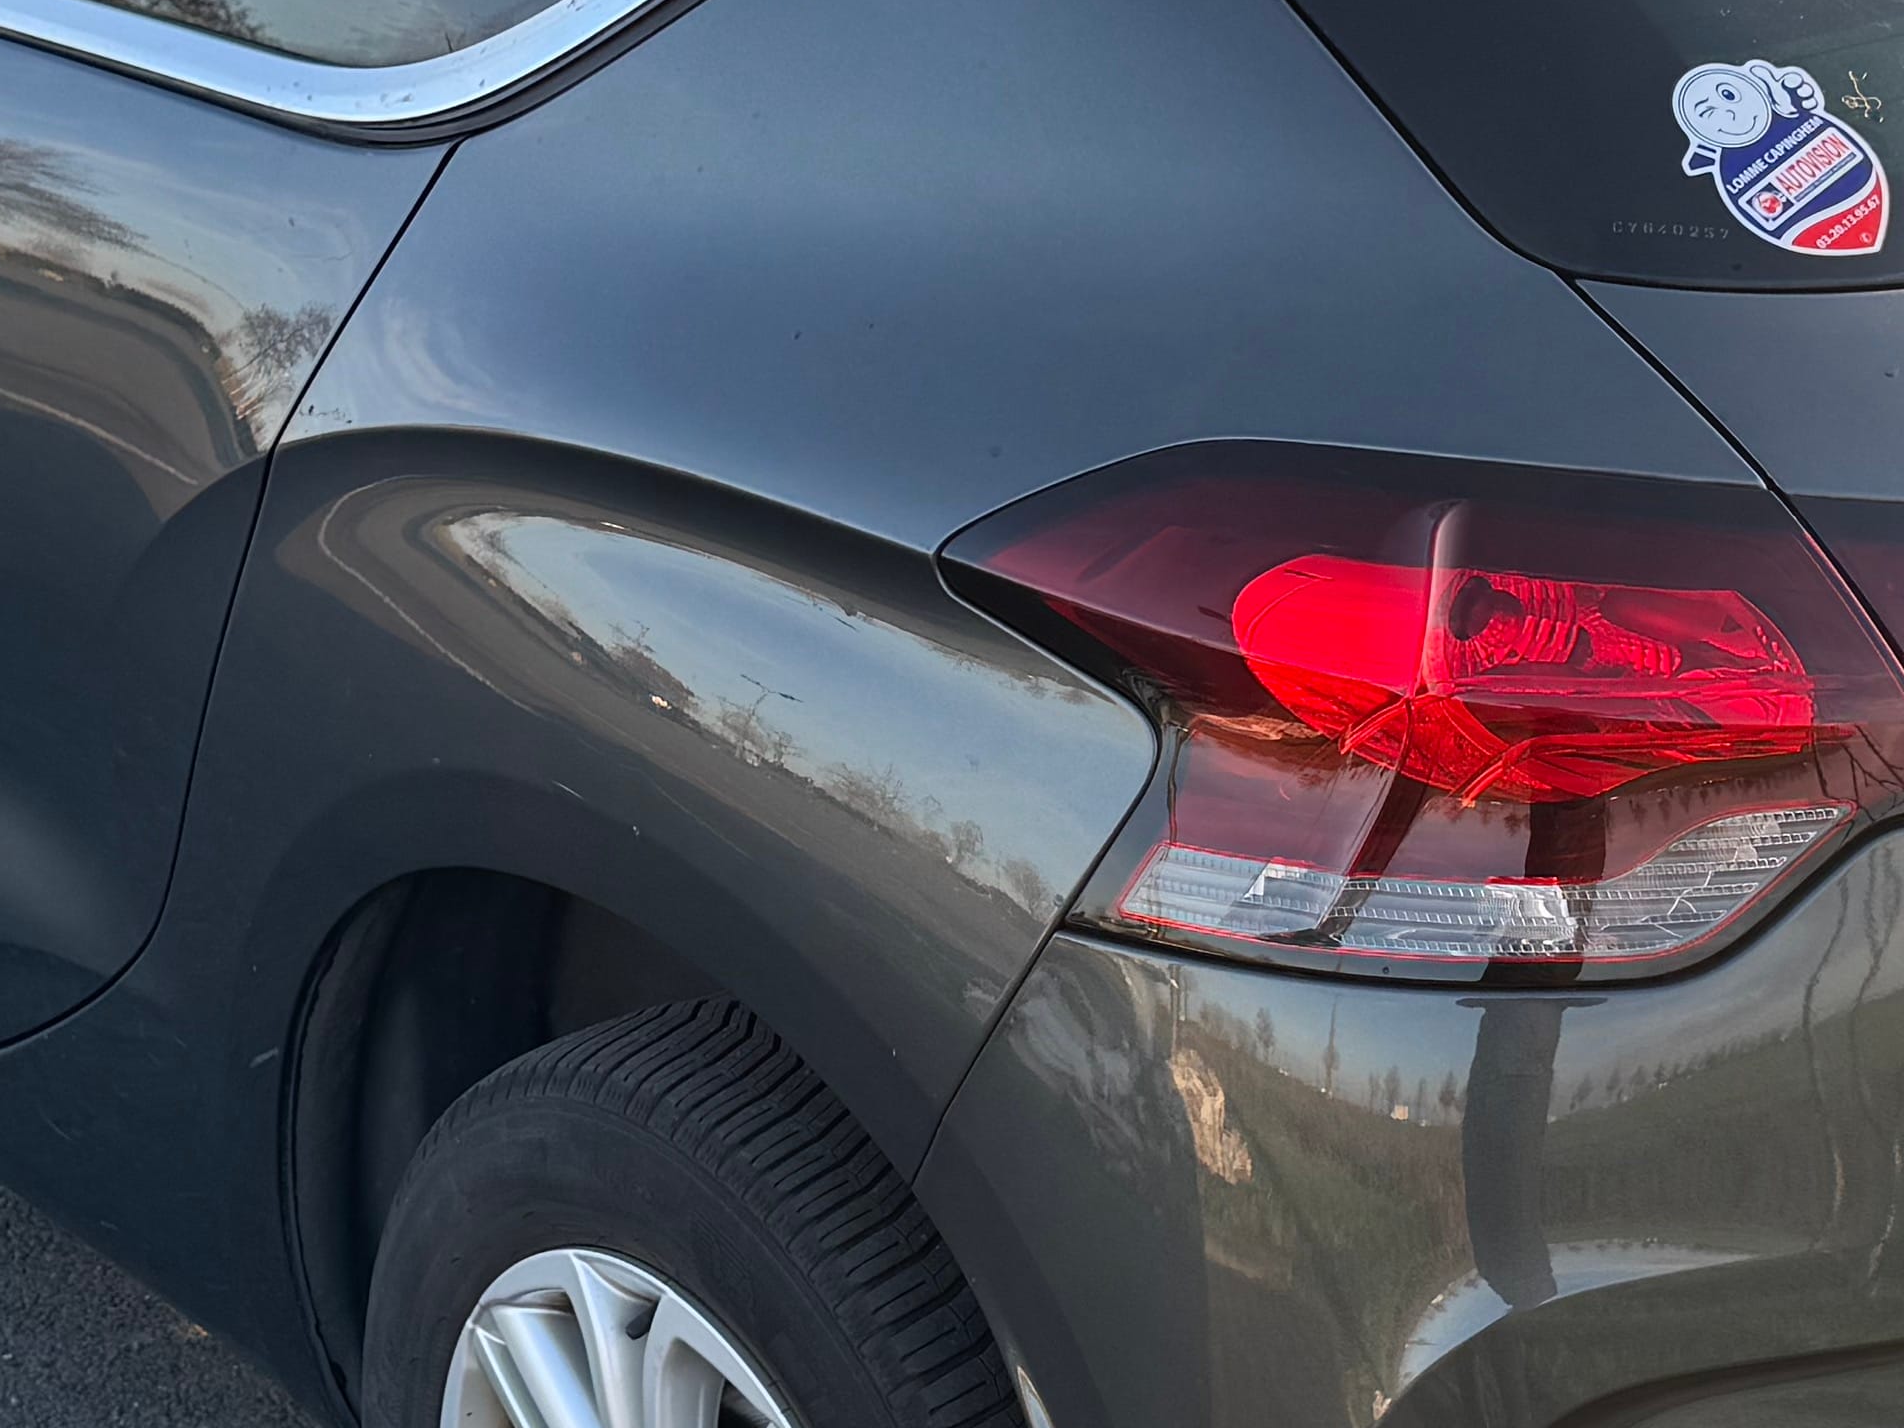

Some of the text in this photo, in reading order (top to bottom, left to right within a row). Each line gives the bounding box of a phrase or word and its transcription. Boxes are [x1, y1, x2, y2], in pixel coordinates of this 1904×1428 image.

[1726, 158, 1769, 195] LOMME
[1763, 116, 1824, 163] CAPINGHEM
[1776, 133, 1850, 195] AUTOVISION
[1815, 194, 1881, 249] 03.20.13.95.67
